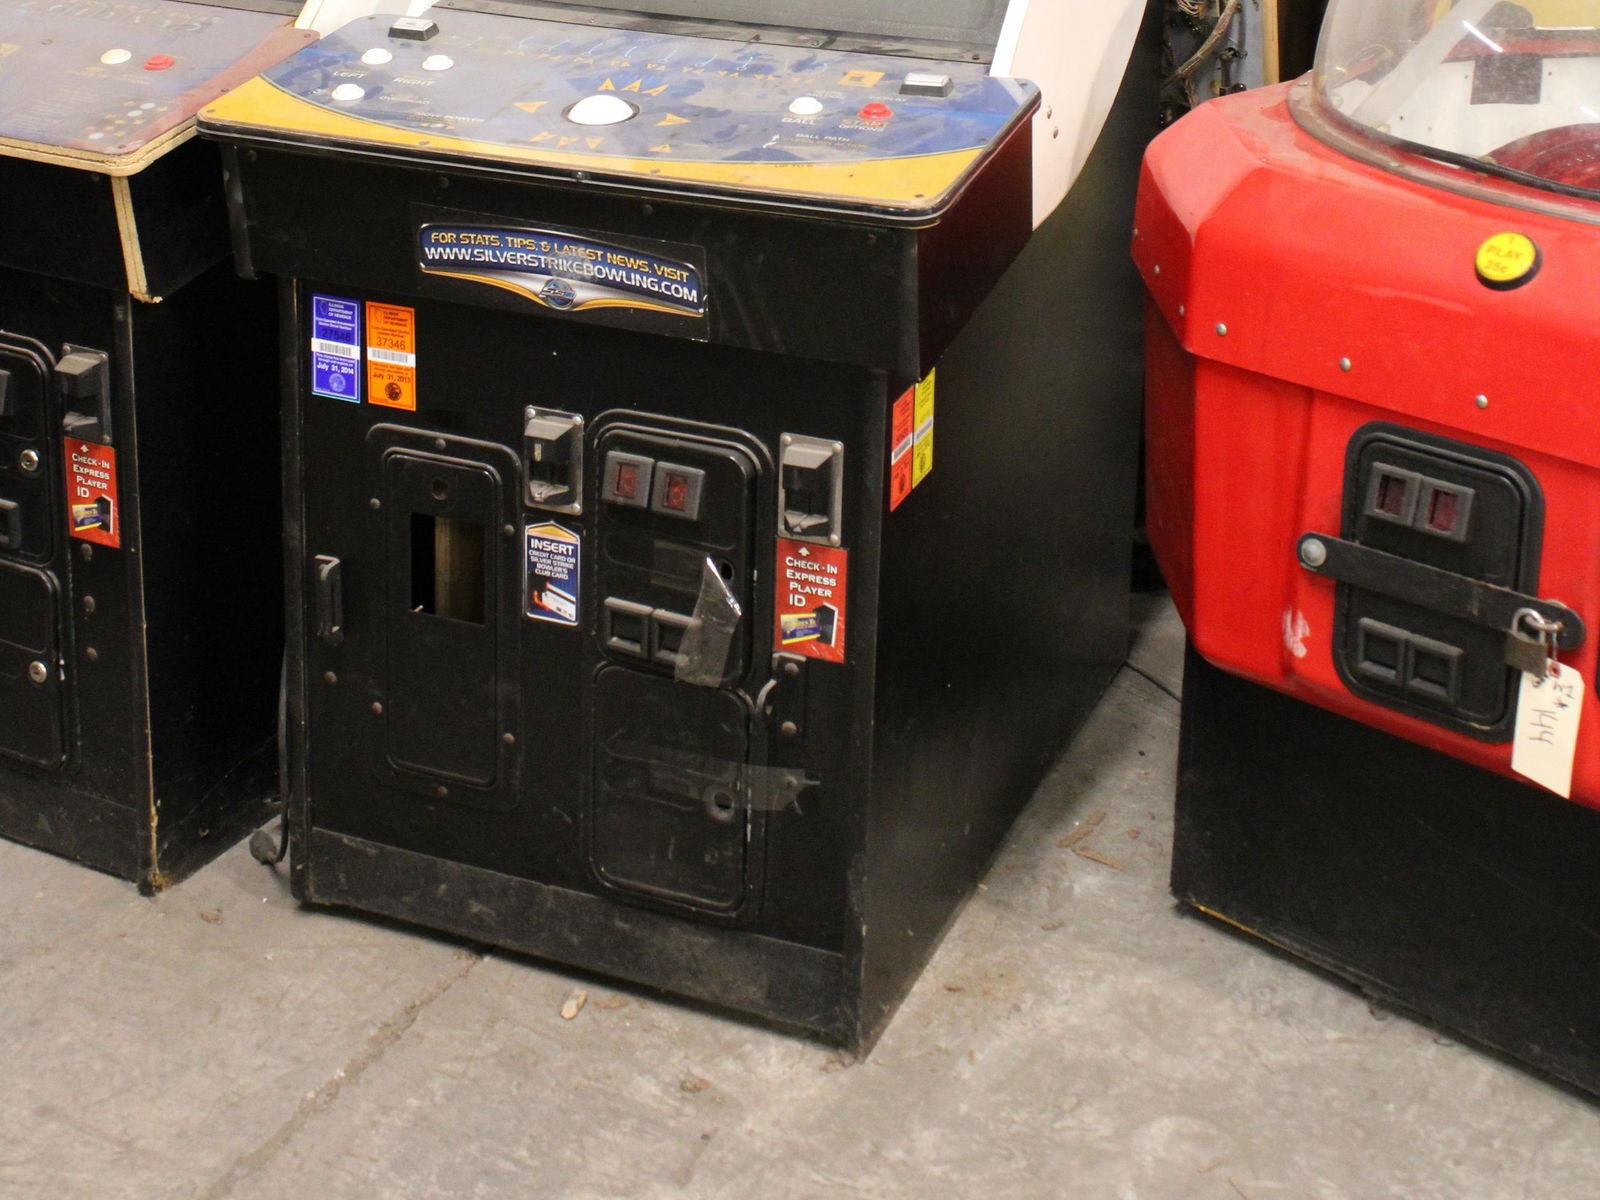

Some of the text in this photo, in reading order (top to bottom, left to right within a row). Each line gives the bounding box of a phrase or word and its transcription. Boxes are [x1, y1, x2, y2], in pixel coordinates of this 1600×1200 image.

[431, 232, 457, 244] FOR
[541, 241, 552, 252] &
[554, 243, 604, 262] LATEST
[654, 264, 689, 283] VISIT
[425, 247, 698, 303] WWW.SILVERSTRIKEBOWLING.COM
[73, 464, 110, 480] EXPRESS
[76, 475, 109, 490] PLAYER
[77, 486, 90, 498] ID
[530, 538, 575, 556] INSERT
[786, 568, 837, 587] EXPRESS
[789, 581, 833, 598] PLAYER
[789, 593, 806, 607] ID
